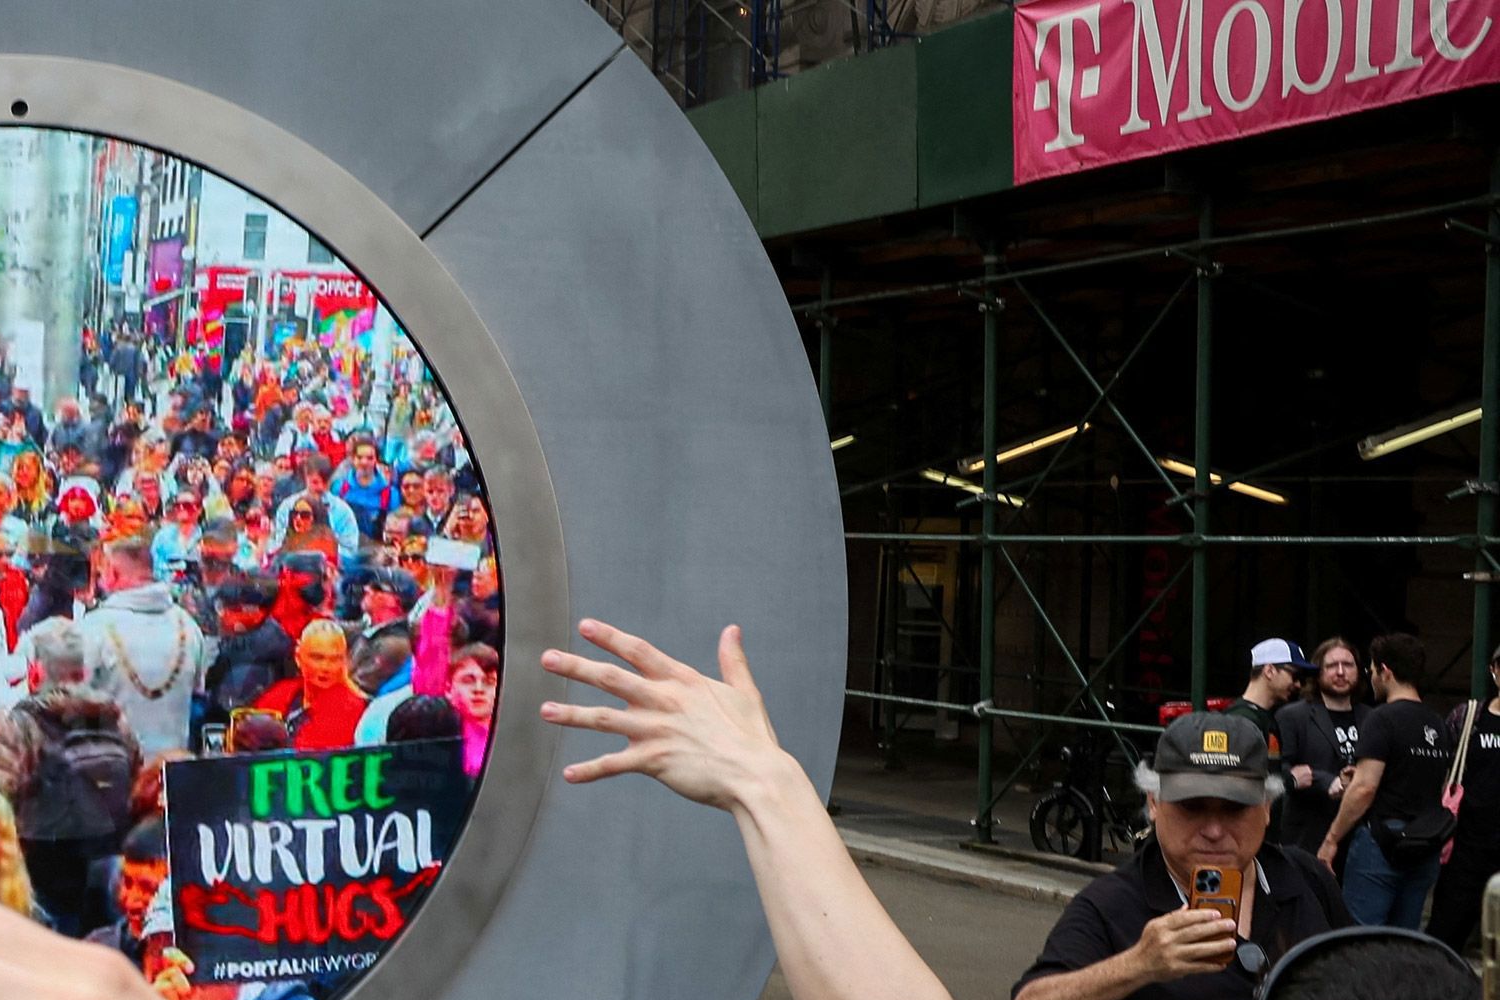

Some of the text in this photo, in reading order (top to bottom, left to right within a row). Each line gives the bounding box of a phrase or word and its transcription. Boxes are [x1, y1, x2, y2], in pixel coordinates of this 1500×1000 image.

[252, 752, 396, 816] FREE
[197, 809, 442, 887] VIRTUAL
[256, 876, 405, 944] HUGS
